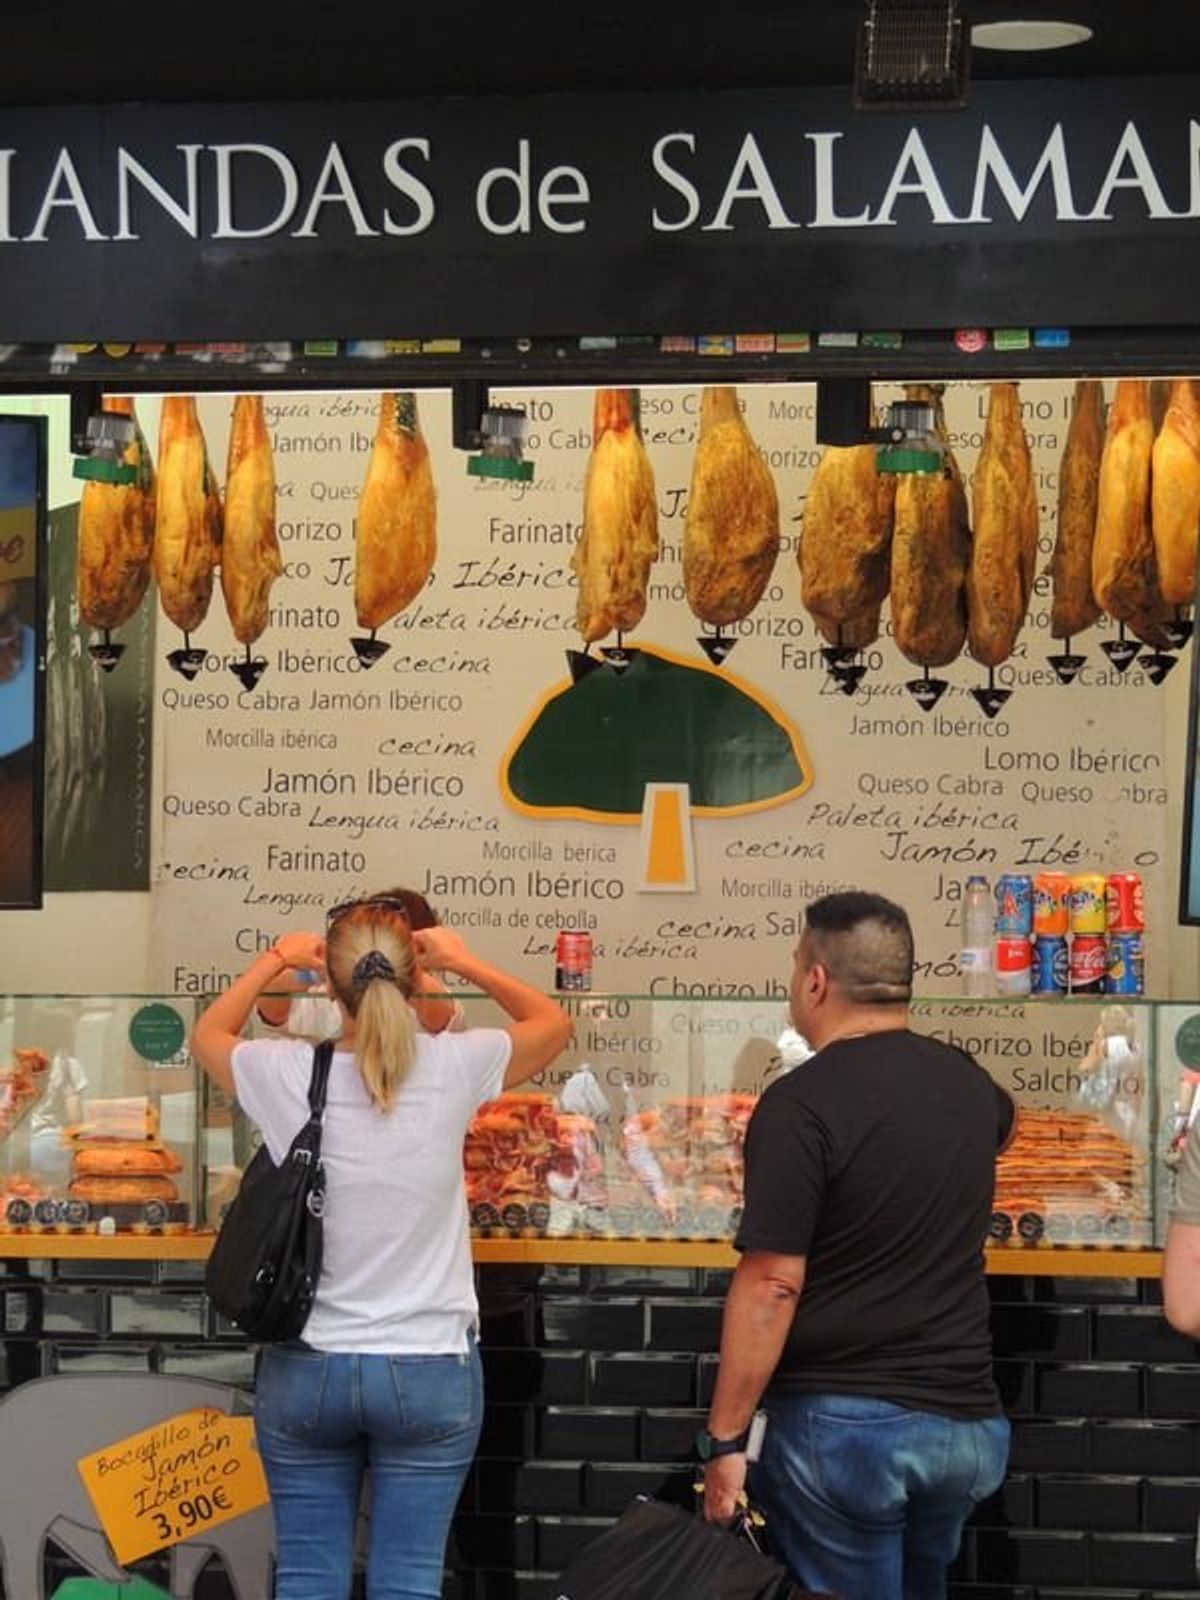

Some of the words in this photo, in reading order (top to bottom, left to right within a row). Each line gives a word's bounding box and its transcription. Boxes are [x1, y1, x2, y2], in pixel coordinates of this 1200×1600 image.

[476, 139, 590, 235] de
[310, 482, 360, 502] Ques
[278, 520, 342, 541] orizo
[269, 604, 340, 629] rinato
[393, 604, 466, 631] aleta
[278, 648, 363, 674] Ibérico
[393, 650, 492, 674] cecina
[162, 688, 229, 711] Queso
[237, 689, 301, 711] Cabra
[308, 689, 381, 711] Jamón
[389, 688, 463, 712] Ibérico
[205, 727, 275, 748] Morcilla
[281, 728, 338, 749] ibérica
[848, 716, 924, 737] Jamón
[933, 714, 1010, 738] Ibérico
[378, 733, 478, 756] cecina
[984, 746, 1060, 771] Lomo
[262, 768, 355, 796] Jamón
[367, 768, 464, 797] Ibérico
[858, 772, 929, 797] Queso
[937, 773, 1003, 797] Cabra
[1021, 781, 1093, 805] Queso
[162, 795, 231, 818] Queso
[238, 796, 302, 818] Cabra
[807, 802, 903, 830] Paleta
[913, 799, 1019, 831] ibérica
[308, 805, 400, 840] Lengua
[409, 806, 501, 833] ibérica
[267, 845, 366, 874] Farinato
[482, 840, 553, 862] Morcilla
[725, 836, 826, 860] cecina
[880, 831, 997, 865] Jamón
[421, 869, 516, 898] Jamón
[527, 869, 624, 900] Ibérico
[721, 877, 792, 898] Morcilla
[242, 885, 326, 915] Lengua
[507, 908, 530, 928] de
[535, 908, 598, 930] cebolla
[655, 917, 756, 941] cecina
[616, 936, 699, 960] ibérica
[174, 966, 245, 993] Farin
[198, 1409, 220, 1430] de
[142, 1433, 231, 1482] Jamón
[133, 1458, 241, 1518] Ibérico
[151, 1485, 233, 1540] 3,90€
